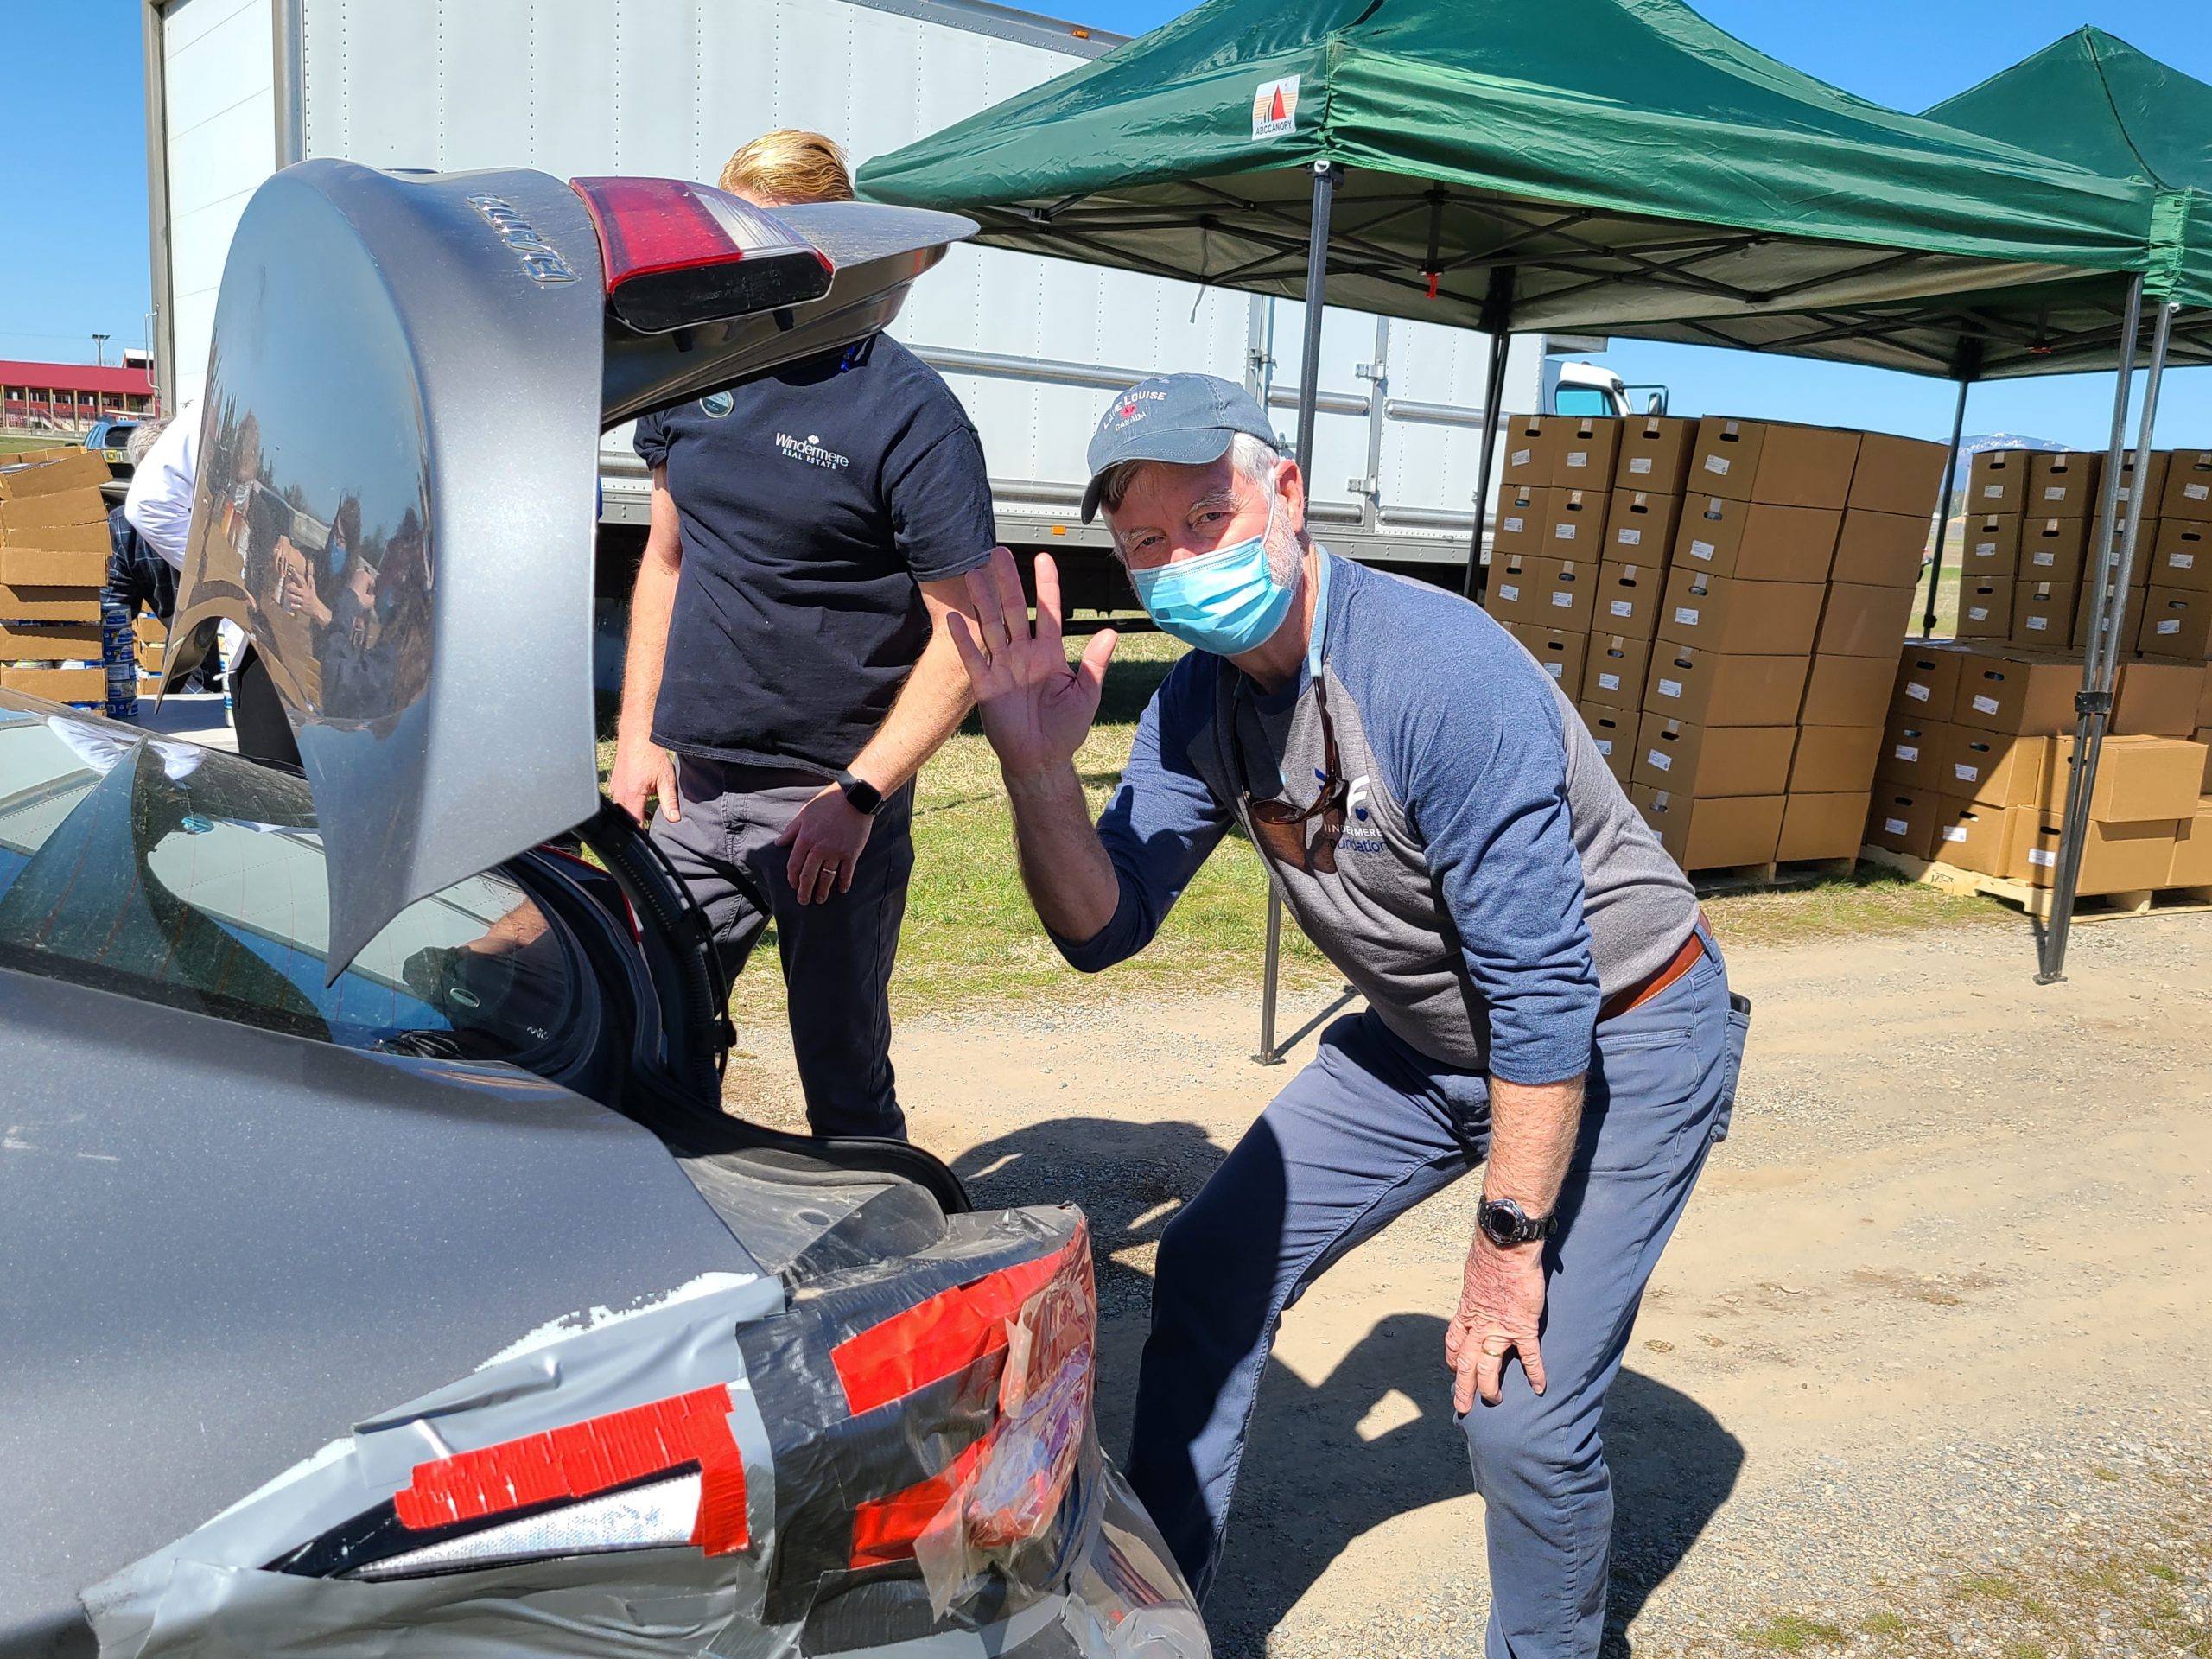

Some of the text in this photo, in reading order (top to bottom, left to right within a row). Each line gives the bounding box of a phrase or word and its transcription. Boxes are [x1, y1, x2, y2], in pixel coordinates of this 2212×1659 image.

[1255, 120, 1292, 136] ABCCANOPY
[1123, 391, 1166, 406] LOUISE
[1115, 411, 1147, 432] CANADA
[775, 432, 849, 467] Windermere
[782, 448, 836, 470] REAL ESTATE
[1329, 836, 1386, 852] oundatio
